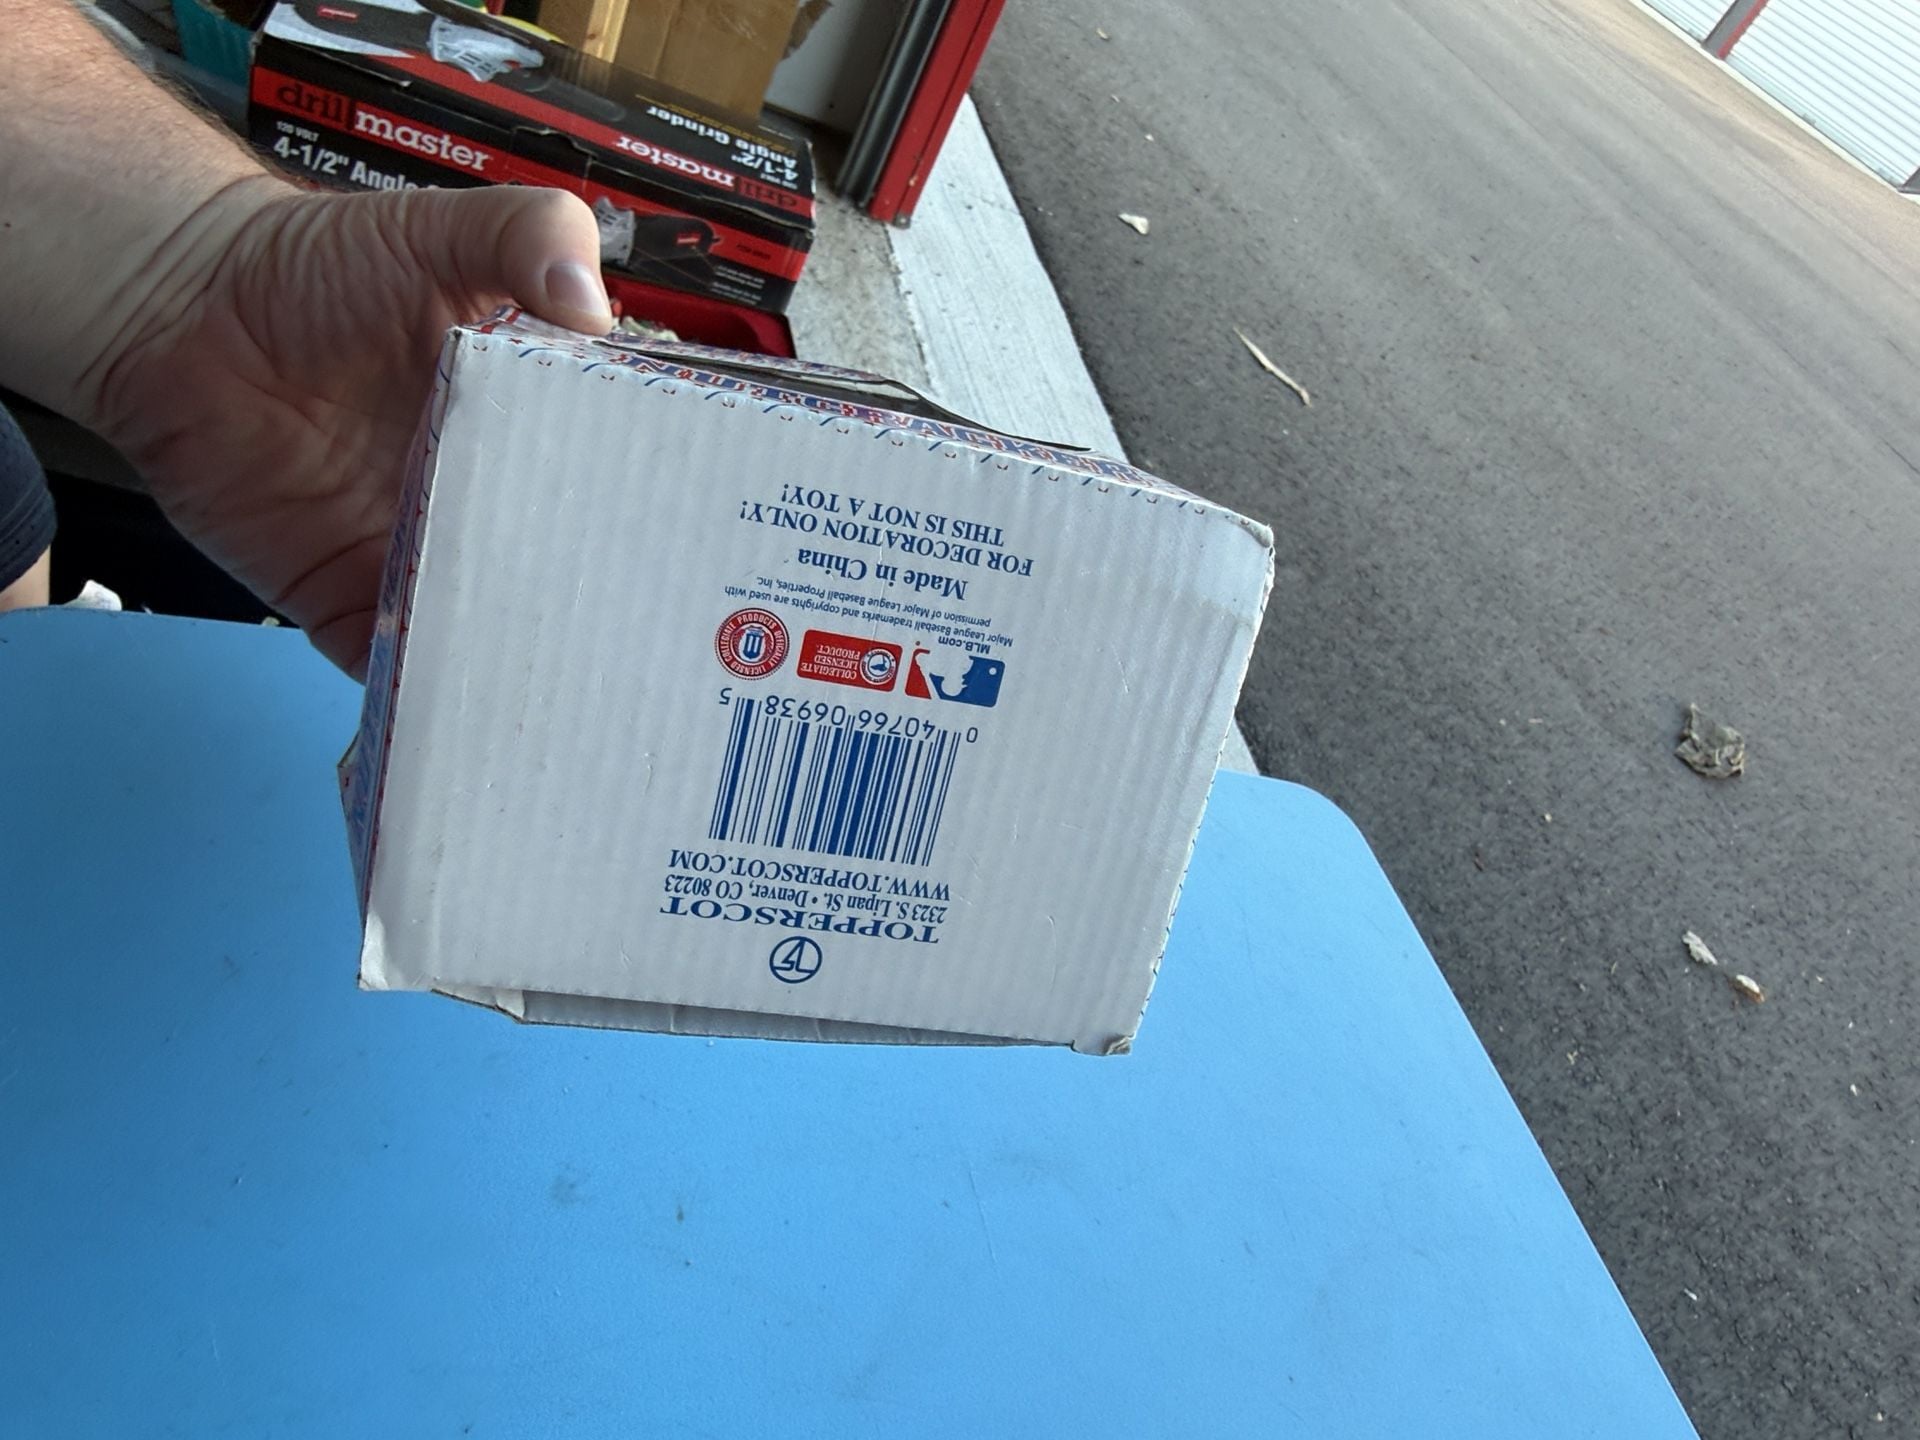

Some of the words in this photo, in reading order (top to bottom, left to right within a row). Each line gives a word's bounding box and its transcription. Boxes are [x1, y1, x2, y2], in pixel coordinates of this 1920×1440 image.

[276, 80, 354, 131] drill
[354, 109, 492, 171] master
[295, 126, 320, 142] VOLT
[646, 105, 730, 146] Grinder
[273, 136, 349, 175] 4-1/2"
[615, 135, 735, 188] master
[735, 138, 798, 169] Angle
[781, 483, 841, 513] TOY!
[848, 497, 866, 517] A
[740, 501, 818, 533] ONLY!
[868, 502, 921, 530] NOT
[924, 514, 948, 535] IS
[821, 517, 983, 566] DECORATION
[951, 519, 1005, 547] THIS
[797, 548, 868, 581] China
[987, 551, 1035, 577] FOR
[875, 563, 899, 587] in
[903, 568, 969, 601] Made
[724, 585, 747, 597] with
[748, 589, 771, 601] used
[776, 578, 826, 599] Properties,
[827, 590, 867, 606] Baseball
[774, 594, 790, 604] are
[791, 597, 841, 612] copyrights
[867, 597, 901, 610] League
[842, 608, 859, 618] and
[861, 610, 913, 628] trademarks
[903, 602, 930, 618] Major
[931, 610, 942, 620] of
[943, 612, 992, 628] permission
[914, 620, 952, 636] Baseball
[953, 627, 986, 641] League
[937, 636, 991, 655] MLB.com
[986, 633, 1014, 648] Major
[800, 662, 858, 680] COLLEGIATE
[813, 654, 859, 670] LICENSED
[719, 687, 733, 705] 5
[764, 695, 847, 726] 06938
[858, 709, 937, 741] 40766
[966, 727, 979, 744] 0
[664, 874, 712, 897] 80223
[668, 849, 951, 902] WWW.TOPPERSCOT.COM
[715, 880, 744, 900] CO
[748, 880, 809, 908] Denver,
[823, 892, 844, 912] St.
[846, 894, 892, 918] Lipan
[895, 901, 910, 920] S.
[659, 896, 940, 944] TOPPERSCOT
[911, 903, 949, 924] 2323
